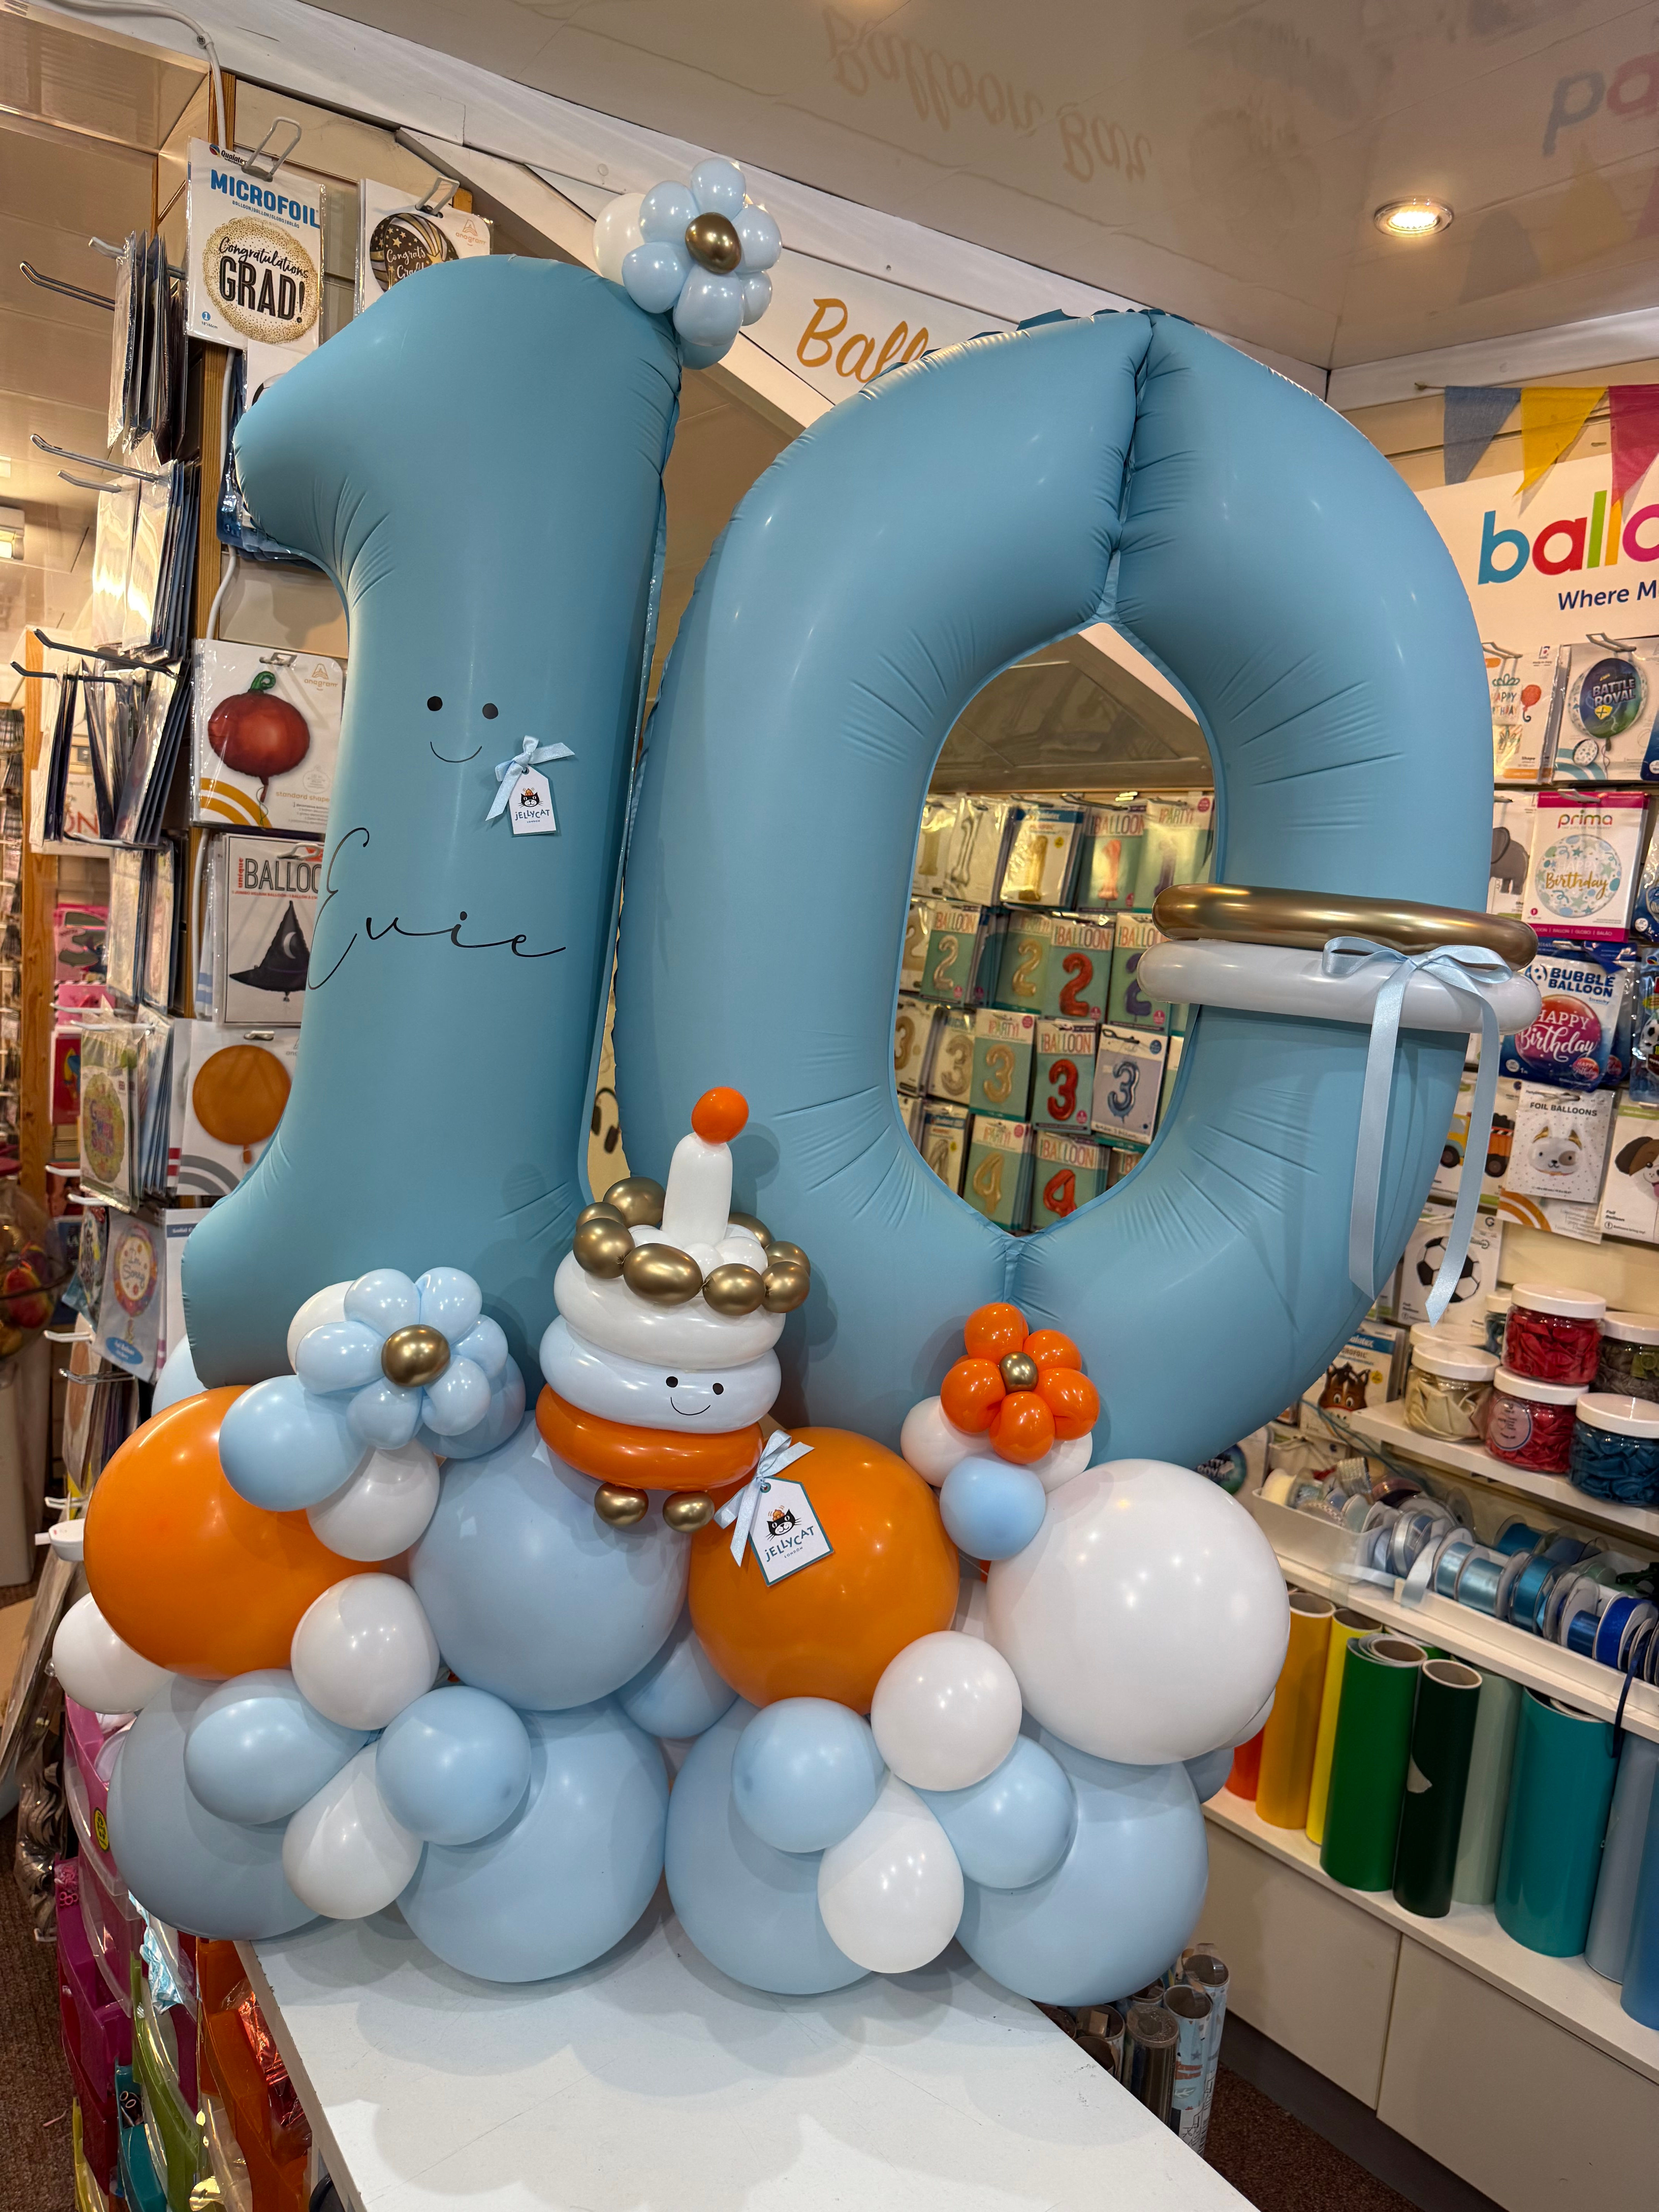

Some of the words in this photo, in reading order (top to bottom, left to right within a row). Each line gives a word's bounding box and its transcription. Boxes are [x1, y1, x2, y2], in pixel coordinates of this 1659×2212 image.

[211, 169, 321, 229] MICROFOIL
[455, 232, 486, 245] anagram
[219, 236, 309, 279] Congratulations
[386, 246, 426, 265] Congrats
[219, 256, 305, 324] GRAD!
[1558, 588, 1630, 611] Where
[304, 679, 338, 687] anagram
[1592, 678, 1635, 696] BATTLE
[1593, 690, 1636, 708] ROYAL
[276, 791, 308, 800] standard
[1558, 809, 1613, 829] prima
[1545, 871, 1609, 900] Birthday
[308, 827, 567, 991] Evie
[1056, 925, 1111, 949] BALLOON
[1549, 967, 1616, 988] BUBBLE
[1548, 979, 1613, 998] BALLOON
[1538, 1009, 1590, 1030] HAPPY
[1044, 1033, 1091, 1054] BALLOON
[1520, 1024, 1598, 1063] Birthday
[1530, 1102, 1548, 1111] FOIL
[1550, 1104, 1598, 1117] BALLOONS
[1042, 1139, 1095, 1169] BALLOON
[784, 1547, 803, 1558] LONDON
